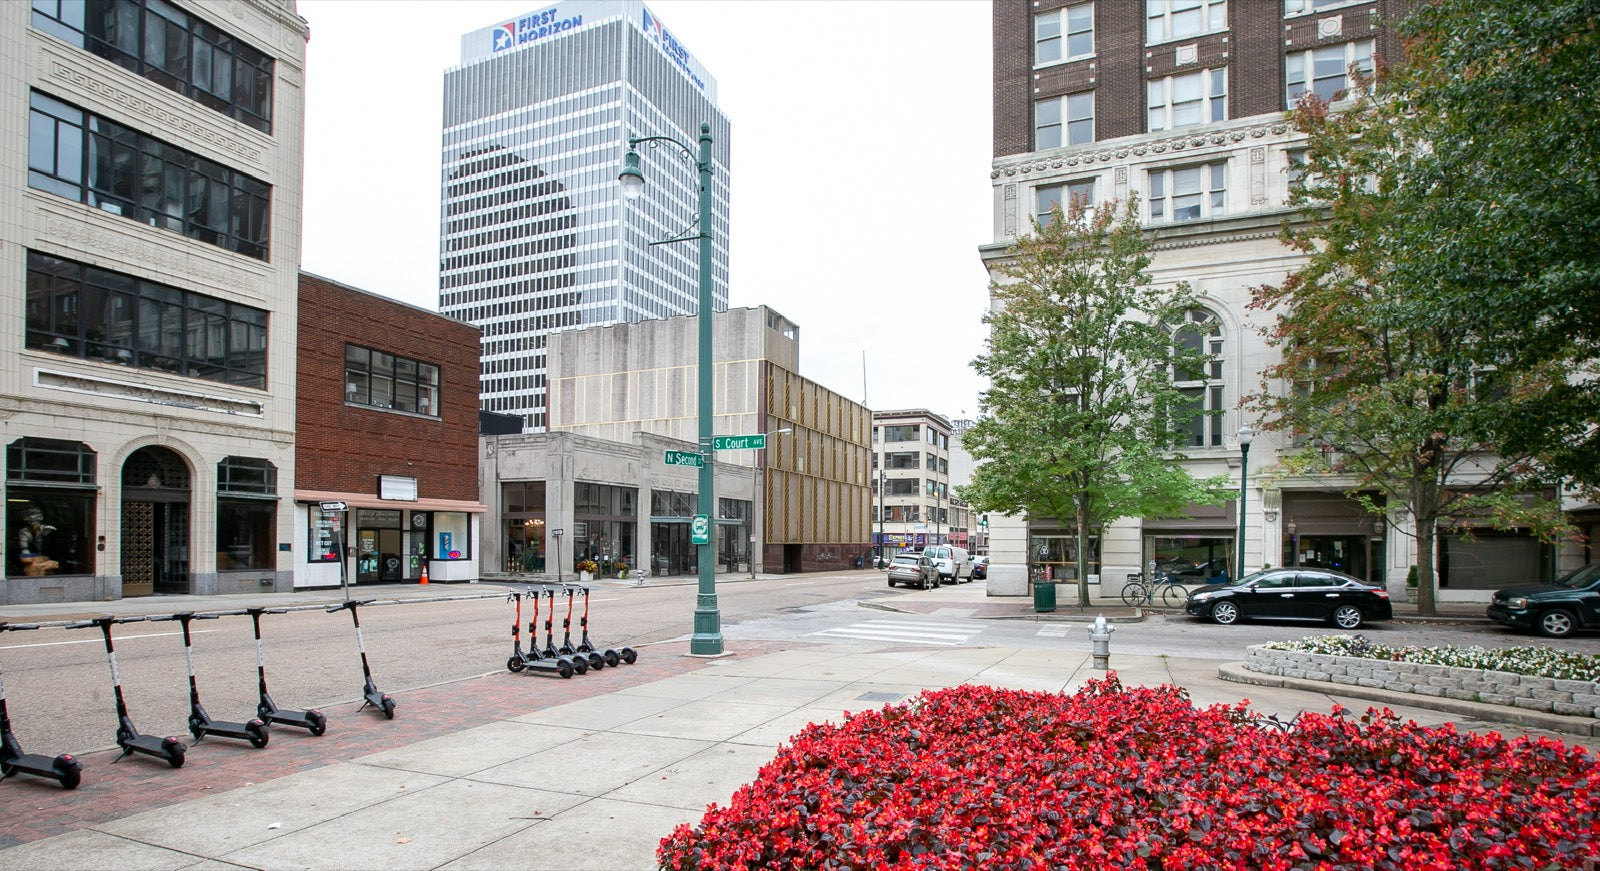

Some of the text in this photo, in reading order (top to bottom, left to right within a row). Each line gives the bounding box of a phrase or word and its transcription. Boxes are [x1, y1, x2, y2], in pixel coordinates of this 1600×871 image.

[518, 8, 557, 32] FIRST
[518, 15, 583, 45] HORIZON
[662, 28, 690, 64] FIRST
[715, 439, 721, 449] S
[725, 437, 749, 449] Court
[667, 453, 673, 463] N
[675, 453, 697, 466] Second
